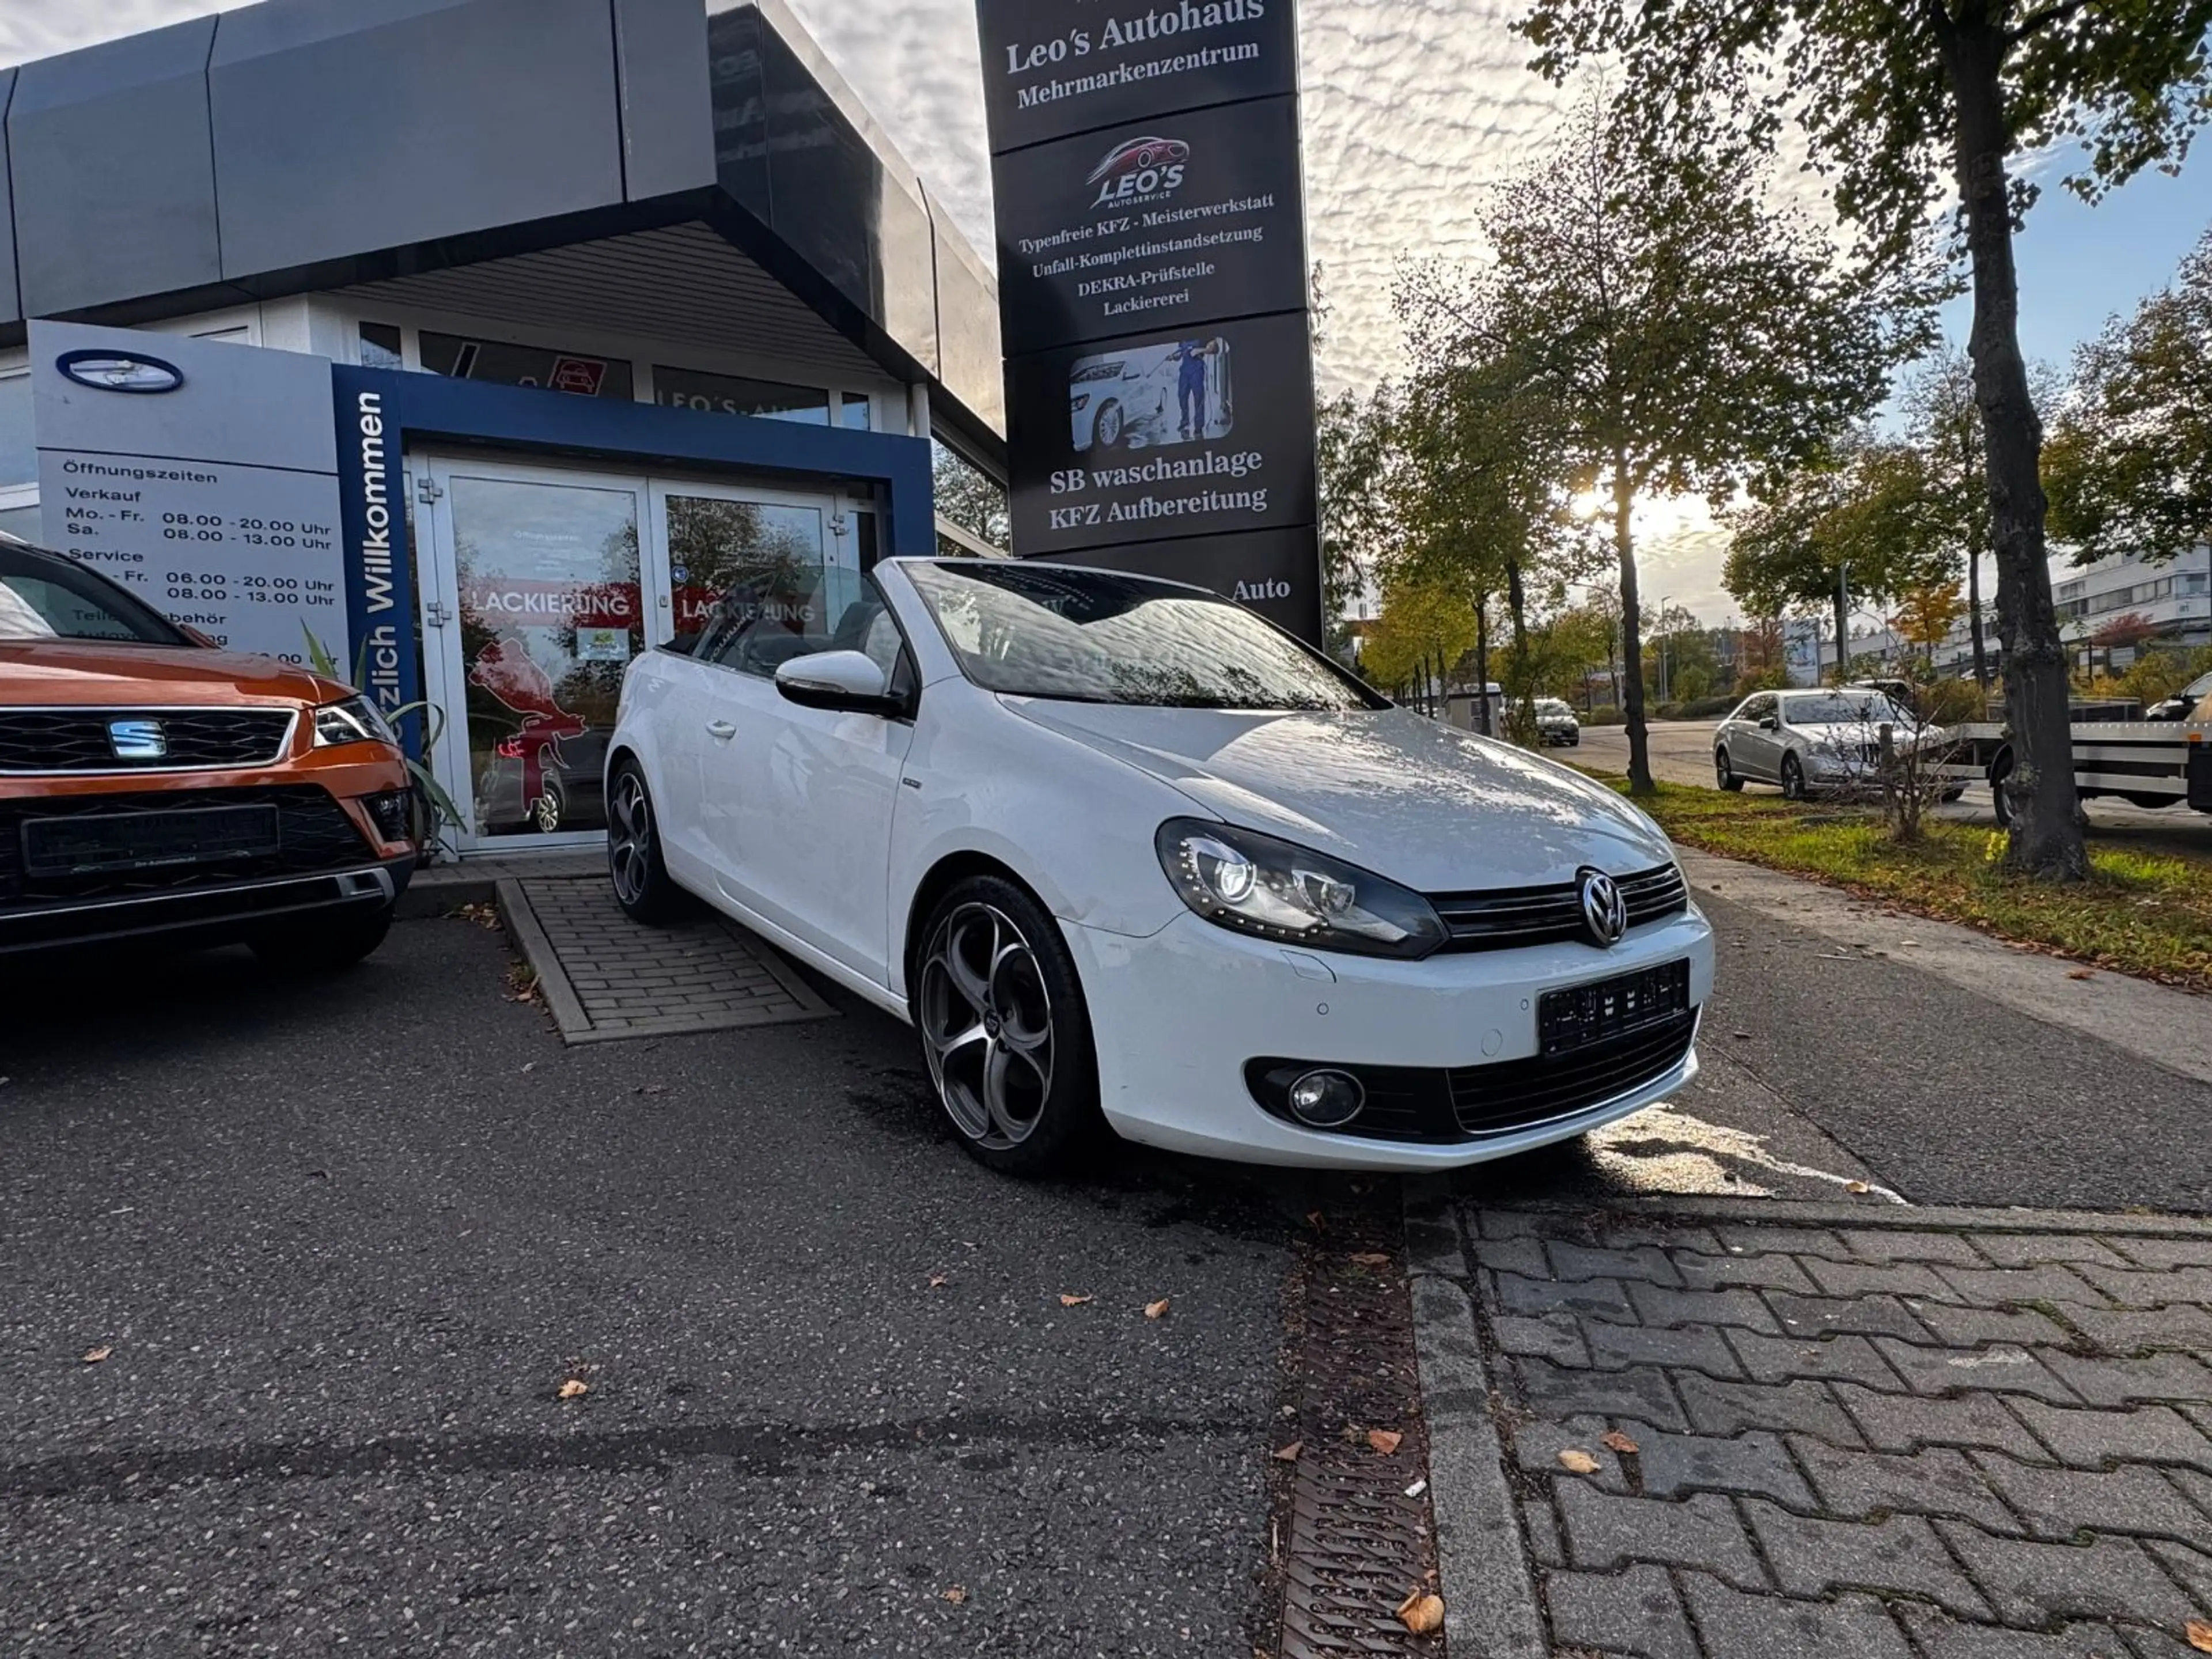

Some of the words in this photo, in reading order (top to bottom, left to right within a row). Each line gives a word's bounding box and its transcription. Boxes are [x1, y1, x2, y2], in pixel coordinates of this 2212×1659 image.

[1006, 29, 1091, 74] Leo's
[1099, 0, 1265, 50] Autohaus
[1017, 43, 1259, 109] Mehrmarkenzentrum
[1091, 165, 1184, 209] LEO'S
[1108, 190, 1171, 209] AUTOSERVICE
[1018, 225, 1094, 254] Typenfreie
[1097, 217, 1130, 236] KFZ
[1142, 194, 1274, 228] Meisterwerkstatt
[1032, 226, 1263, 279] Unfall-Komplettinstandsetzung
[1078, 261, 1215, 297] DEKRA-Prüfstelle
[1103, 289, 1190, 316] Lackiererei
[63, 459, 218, 483] Öffnungszeiten
[1050, 469, 1085, 494] SB
[1093, 450, 1262, 488] waschanlage
[65, 487, 141, 502] Verkauf
[358, 392, 393, 613] Willkommen
[66, 507, 103, 520] Mo.
[121, 510, 145, 522] Fr.
[162, 513, 222, 527] 08.00
[240, 518, 294, 532] 20.00
[301, 523, 332, 535] Uhr
[1050, 505, 1101, 530] KFZ
[1107, 488, 1268, 523] Aufbereitung
[67, 522, 99, 536] Sa.
[164, 528, 223, 541] 08.00
[243, 534, 295, 547] 13.00
[302, 539, 332, 550] Uhr
[69, 548, 144, 562] Service
[124, 571, 149, 582] Fr.
[166, 572, 226, 585] 06.00
[243, 576, 297, 589] 20.00
[305, 579, 335, 592] Uhr
[1233, 577, 1290, 601] Auto
[167, 588, 226, 600] 08.00
[247, 592, 298, 604] 13.00
[306, 594, 335, 606] Uhr
[471, 591, 631, 616] LACKIERUNG
